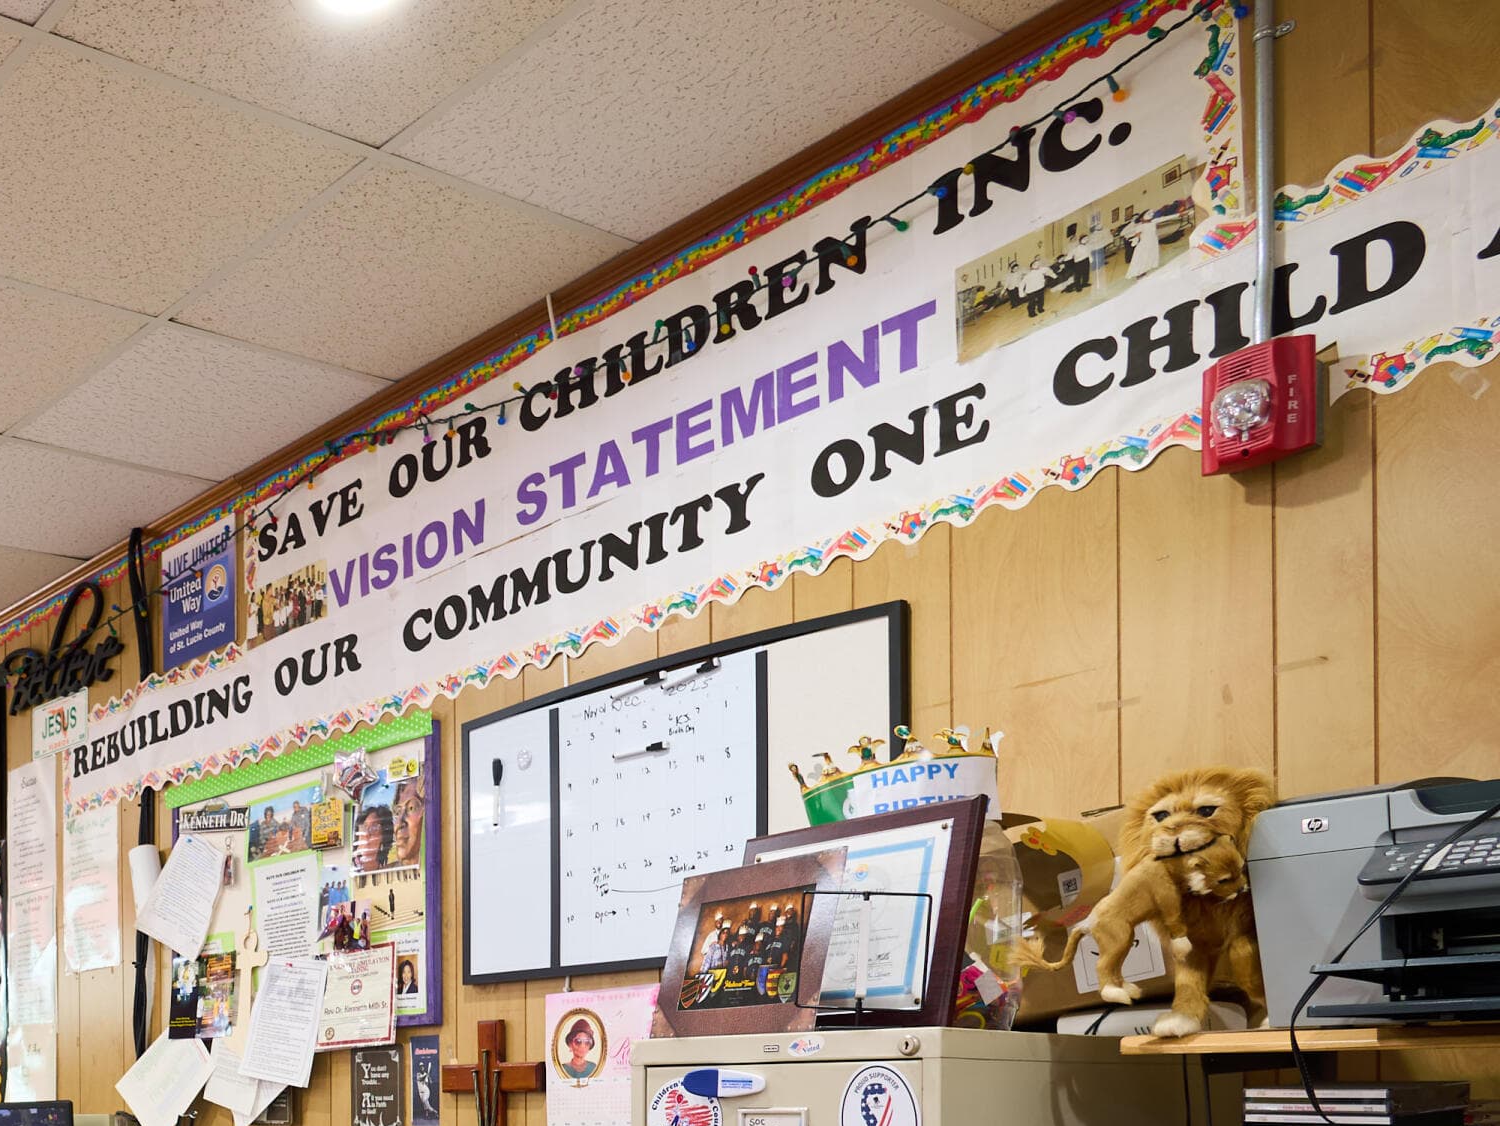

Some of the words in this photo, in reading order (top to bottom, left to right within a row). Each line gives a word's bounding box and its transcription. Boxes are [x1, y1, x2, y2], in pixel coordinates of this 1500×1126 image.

[257, 478, 364, 563] SAVE
[388, 416, 491, 499] OUR
[521, 215, 872, 433] CHILDREN
[933, 97, 1132, 236] INC.
[1286, 374, 1298, 425] FIRE
[330, 499, 486, 609] VISION
[515, 300, 937, 527] STATEMENT
[74, 675, 252, 777] REBUILDING
[275, 632, 361, 696] OUR
[403, 472, 765, 652] COMMUNITY
[811, 382, 990, 499] ONE
[1053, 220, 1426, 406] CHILD
[168, 552, 188, 578] LIVE
[192, 533, 228, 566] UNITED
[169, 577, 202, 604] United
[182, 595, 202, 615] Way
[169, 624, 189, 641] United
[190, 619, 203, 631] Way
[169, 645, 176, 654] of
[177, 640, 185, 651] St.
[186, 633, 202, 647] Lucie
[204, 622, 226, 639] County
[42, 706, 77, 739] JESUS
[871, 763, 959, 789] HAPPY
[183, 810, 228, 830] KENNETH
[1307, 818, 1323, 832] hp
[853, 1076, 868, 1094] PROUD
[869, 1072, 900, 1090] SUPPORTER
